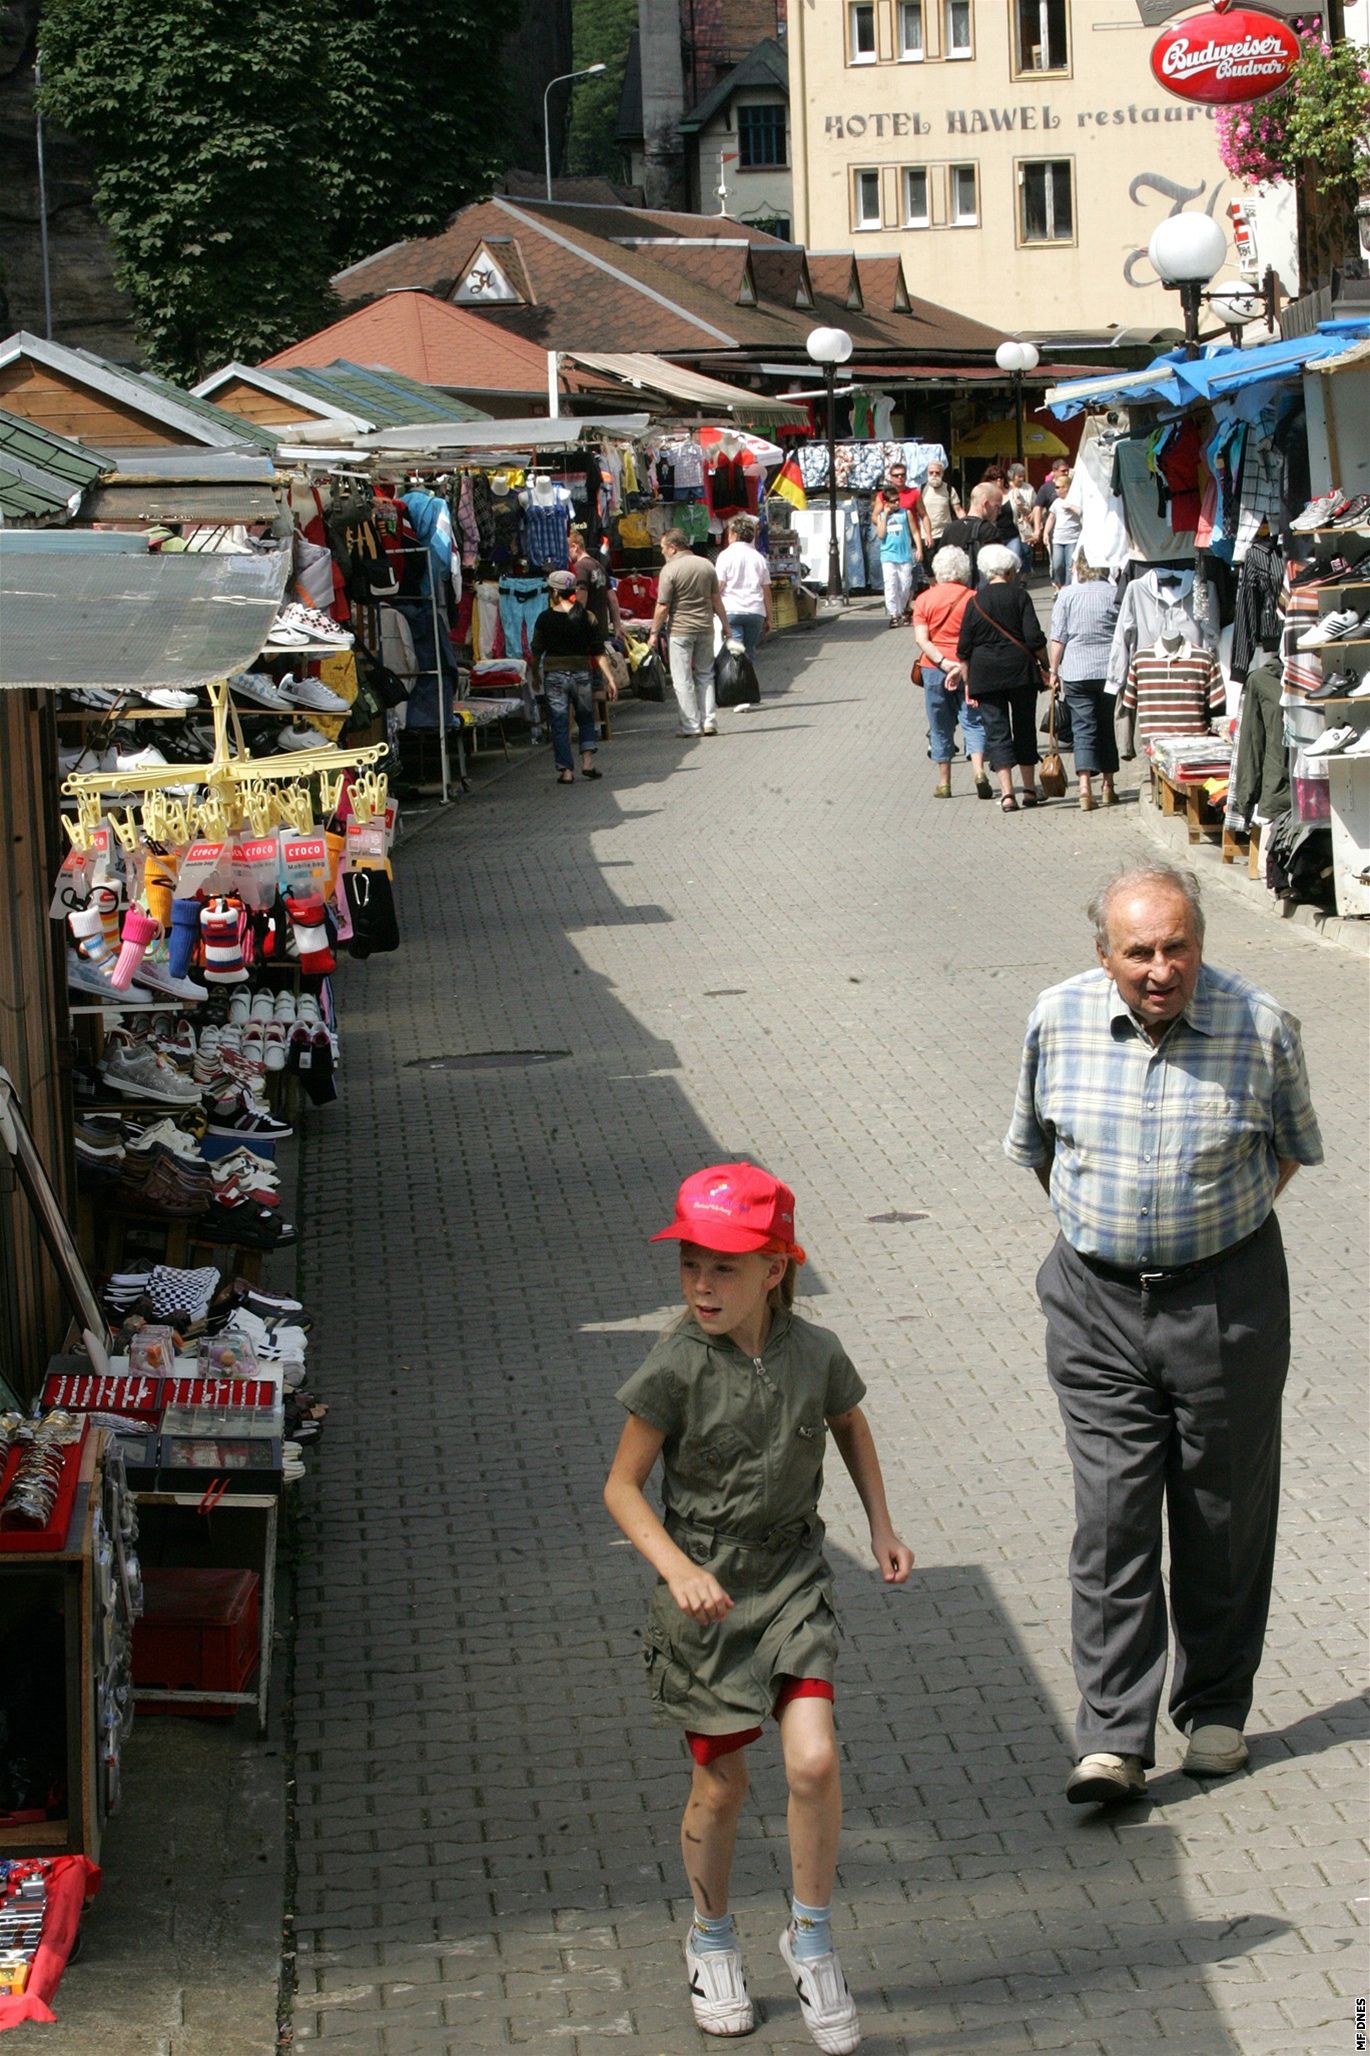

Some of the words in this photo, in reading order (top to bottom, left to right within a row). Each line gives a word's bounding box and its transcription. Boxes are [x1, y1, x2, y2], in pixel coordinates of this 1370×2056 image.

[1162, 35, 1286, 75] Budweiser
[1216, 58, 1284, 79] Budvar
[825, 112, 931, 138] HOTEL
[947, 105, 1060, 133] HAWEL
[192, 848, 219, 857] croco
[246, 845, 273, 856] croco
[288, 845, 321, 856] croco
